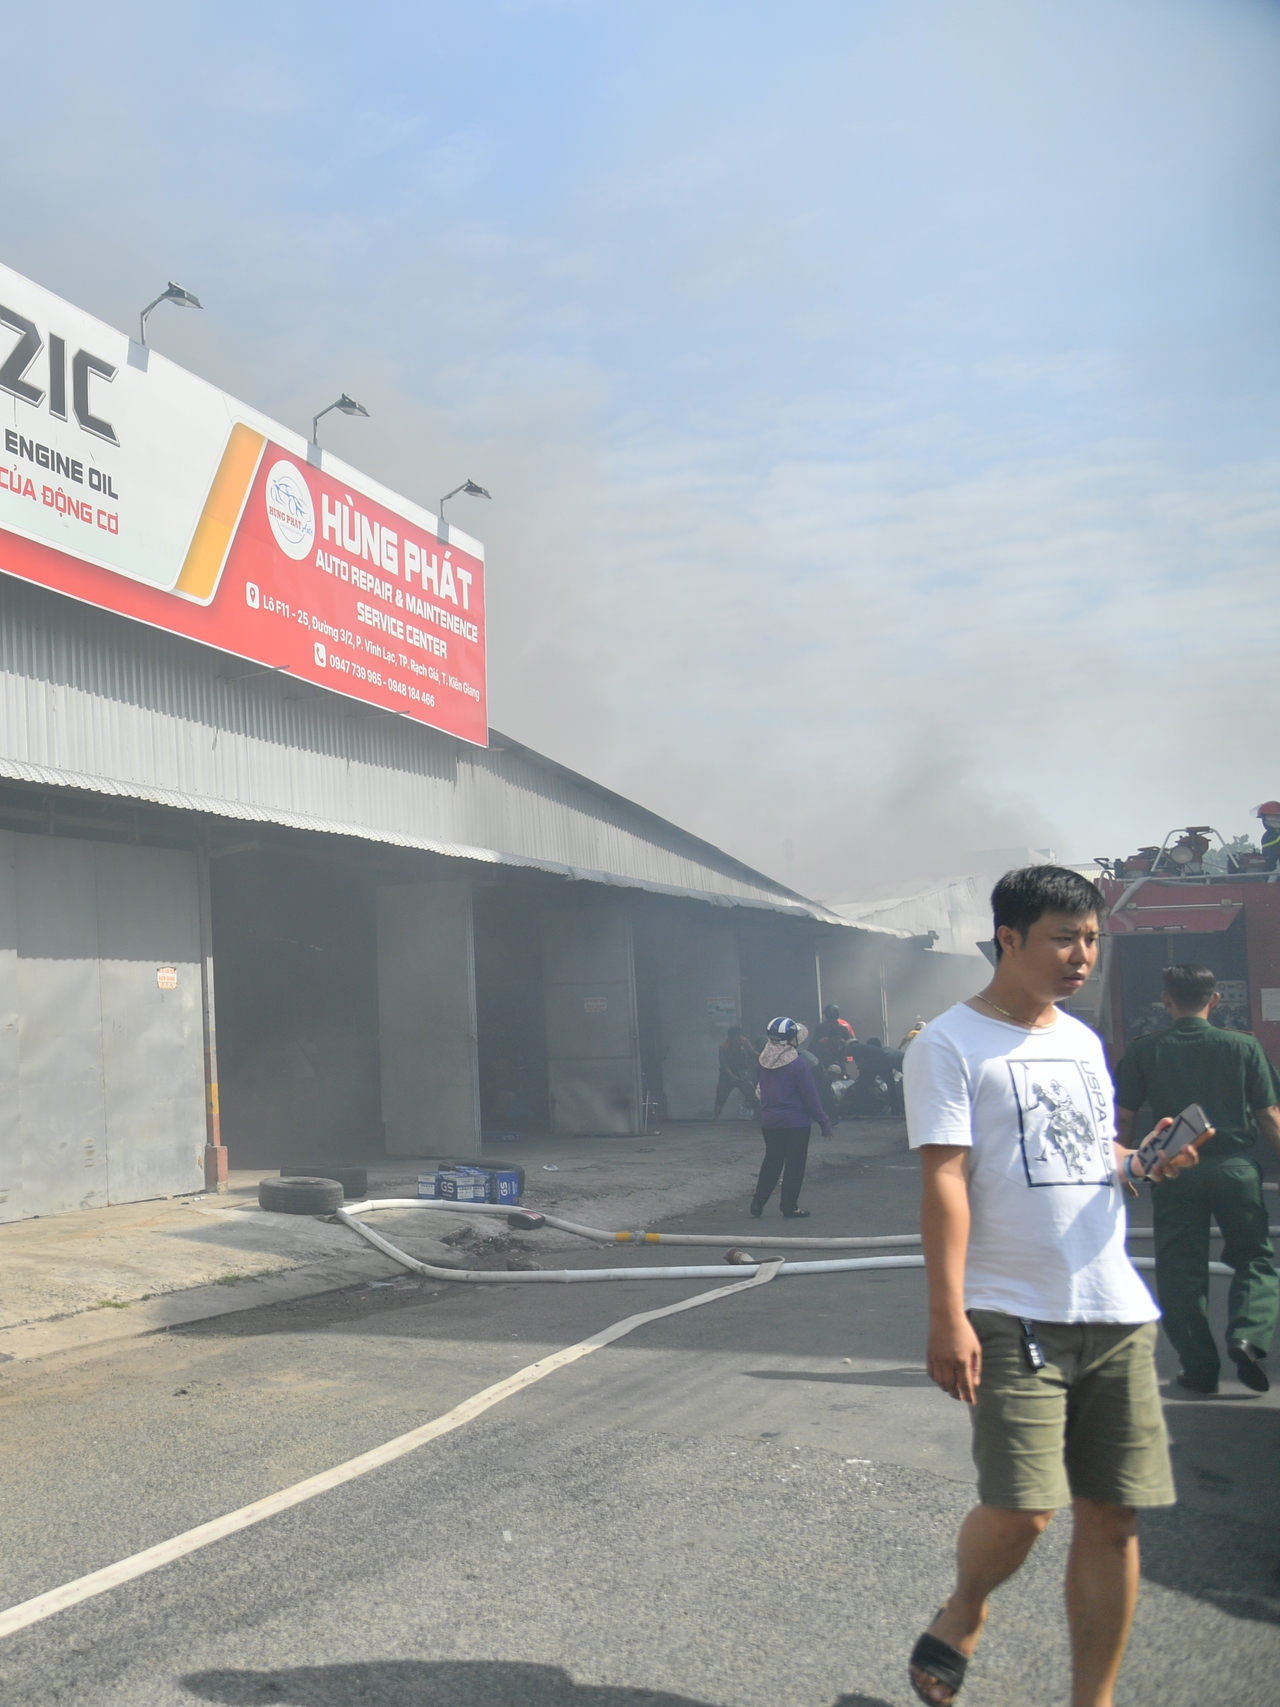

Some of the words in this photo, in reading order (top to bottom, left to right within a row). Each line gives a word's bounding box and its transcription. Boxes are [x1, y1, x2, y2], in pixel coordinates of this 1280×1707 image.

[4, 428, 84, 485] ENGINE
[88, 466, 119, 501] OIL
[42, 484, 93, 526] ĐỘNG
[97, 509, 120, 536] CƠ
[321, 493, 399, 576] HÙNG
[404, 538, 473, 611] PHÁT
[315, 549, 349, 582] AUTO
[351, 565, 393, 604] REPAIR
[395, 588, 404, 609] &
[405, 592, 479, 644] MAINTENENCE
[263, 594, 275, 612] Lô
[276, 599, 290, 619] F11
[297, 609, 311, 631] 25,
[312, 615, 339, 643] Đường
[340, 628, 355, 650] 3/2,
[356, 635, 364, 650] P.
[365, 639, 382, 658] Vĩnh
[382, 649, 398, 668] Lạc,
[398, 653, 410, 670] TP.
[411, 660, 427, 677] Rạch
[428, 666, 441, 686] Giá,
[441, 672, 449, 686] T.
[449, 675, 463, 692] Kiên
[463, 683, 480, 703] Giang
[357, 601, 405, 641] SERVICE
[406, 624, 448, 660] CENTER
[329, 654, 350, 674] 0947
[351, 662, 366, 680] 739
[367, 669, 382, 687] 965
[388, 678, 407, 697] 0948
[407, 686, 420, 702] 184
[421, 691, 435, 708] 466
[440, 1181, 454, 1194] GS
[500, 1181, 508, 1196] GS
